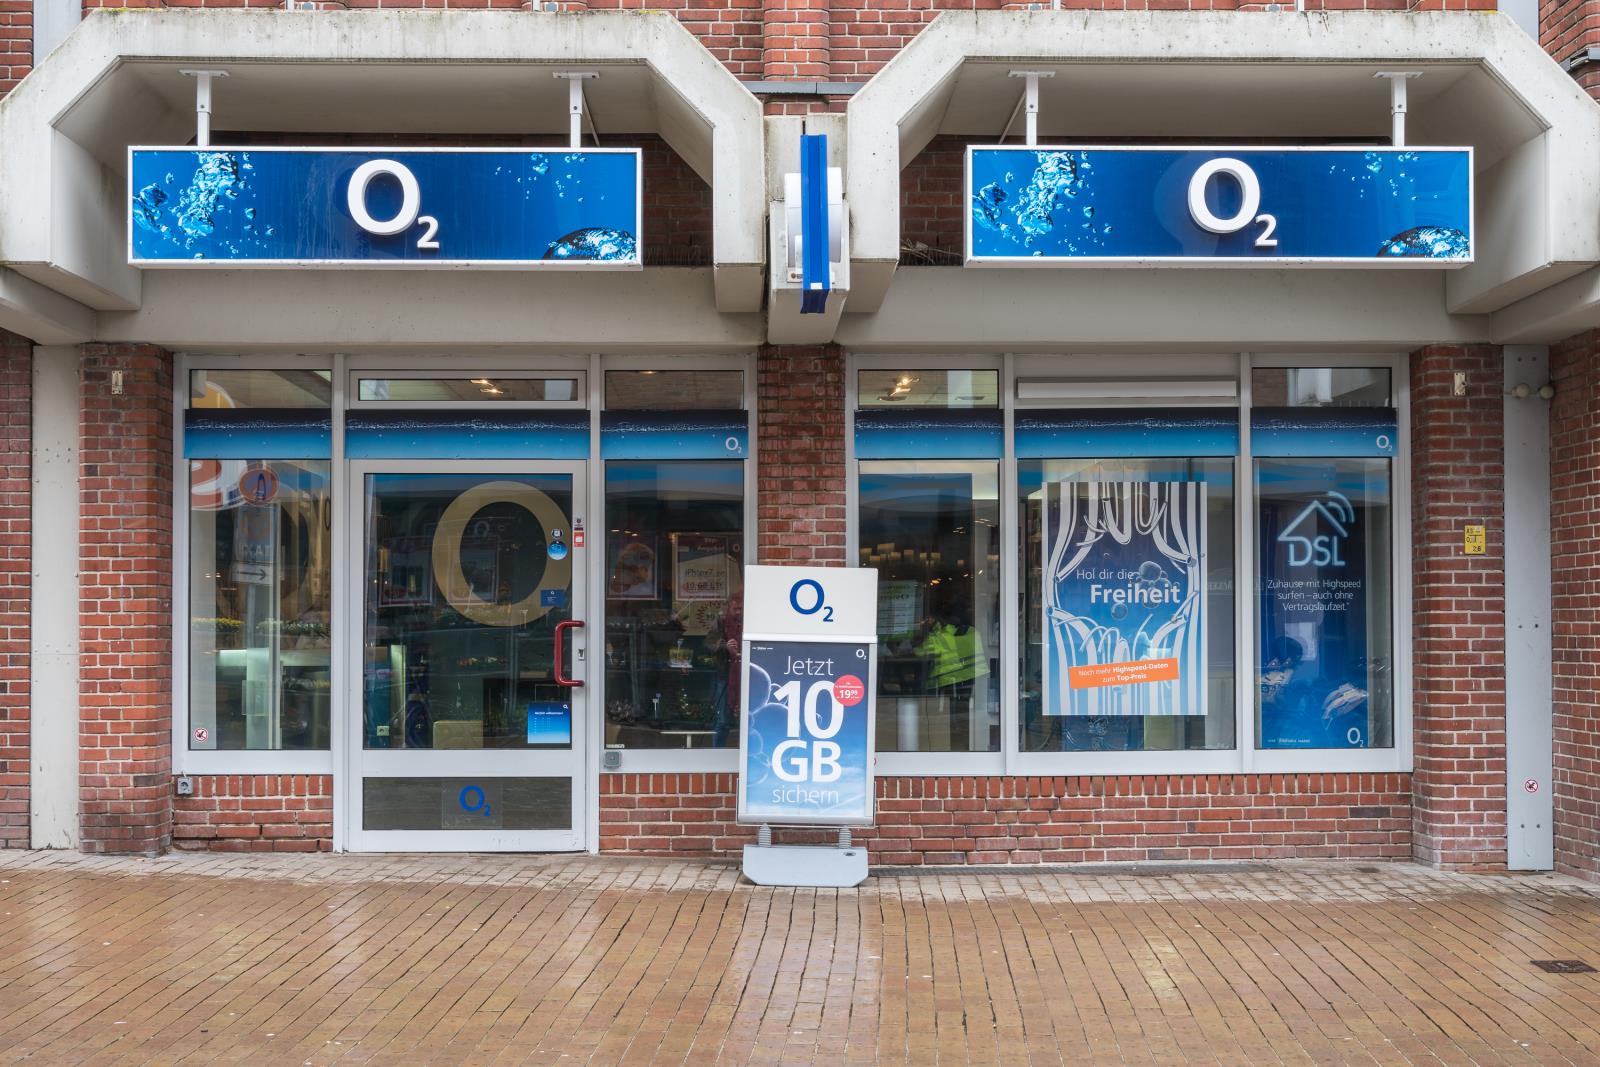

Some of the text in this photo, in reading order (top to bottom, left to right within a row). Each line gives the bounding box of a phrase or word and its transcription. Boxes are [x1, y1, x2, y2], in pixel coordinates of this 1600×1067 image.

[347, 158, 441, 249] O2
[1188, 157, 1278, 247] O2
[725, 436, 742, 454] O2
[1376, 435, 1393, 452] O2
[1283, 535, 1346, 567] DSL
[1076, 568, 1134, 580] Hol dir die
[1267, 579, 1361, 590] Zuhause mit Highspeed
[789, 578, 834, 623] O2
[1090, 583, 1181, 604] Freiheit
[1312, 590, 1333, 600] auch
[1334, 590, 1354, 600] ohne
[783, 655, 835, 676] Jetzt
[773, 680, 844, 739] 10
[1347, 727, 1364, 748] O2
[771, 739, 843, 783] GB
[459, 785, 491, 817] O2
[772, 785, 839, 804] sichern
